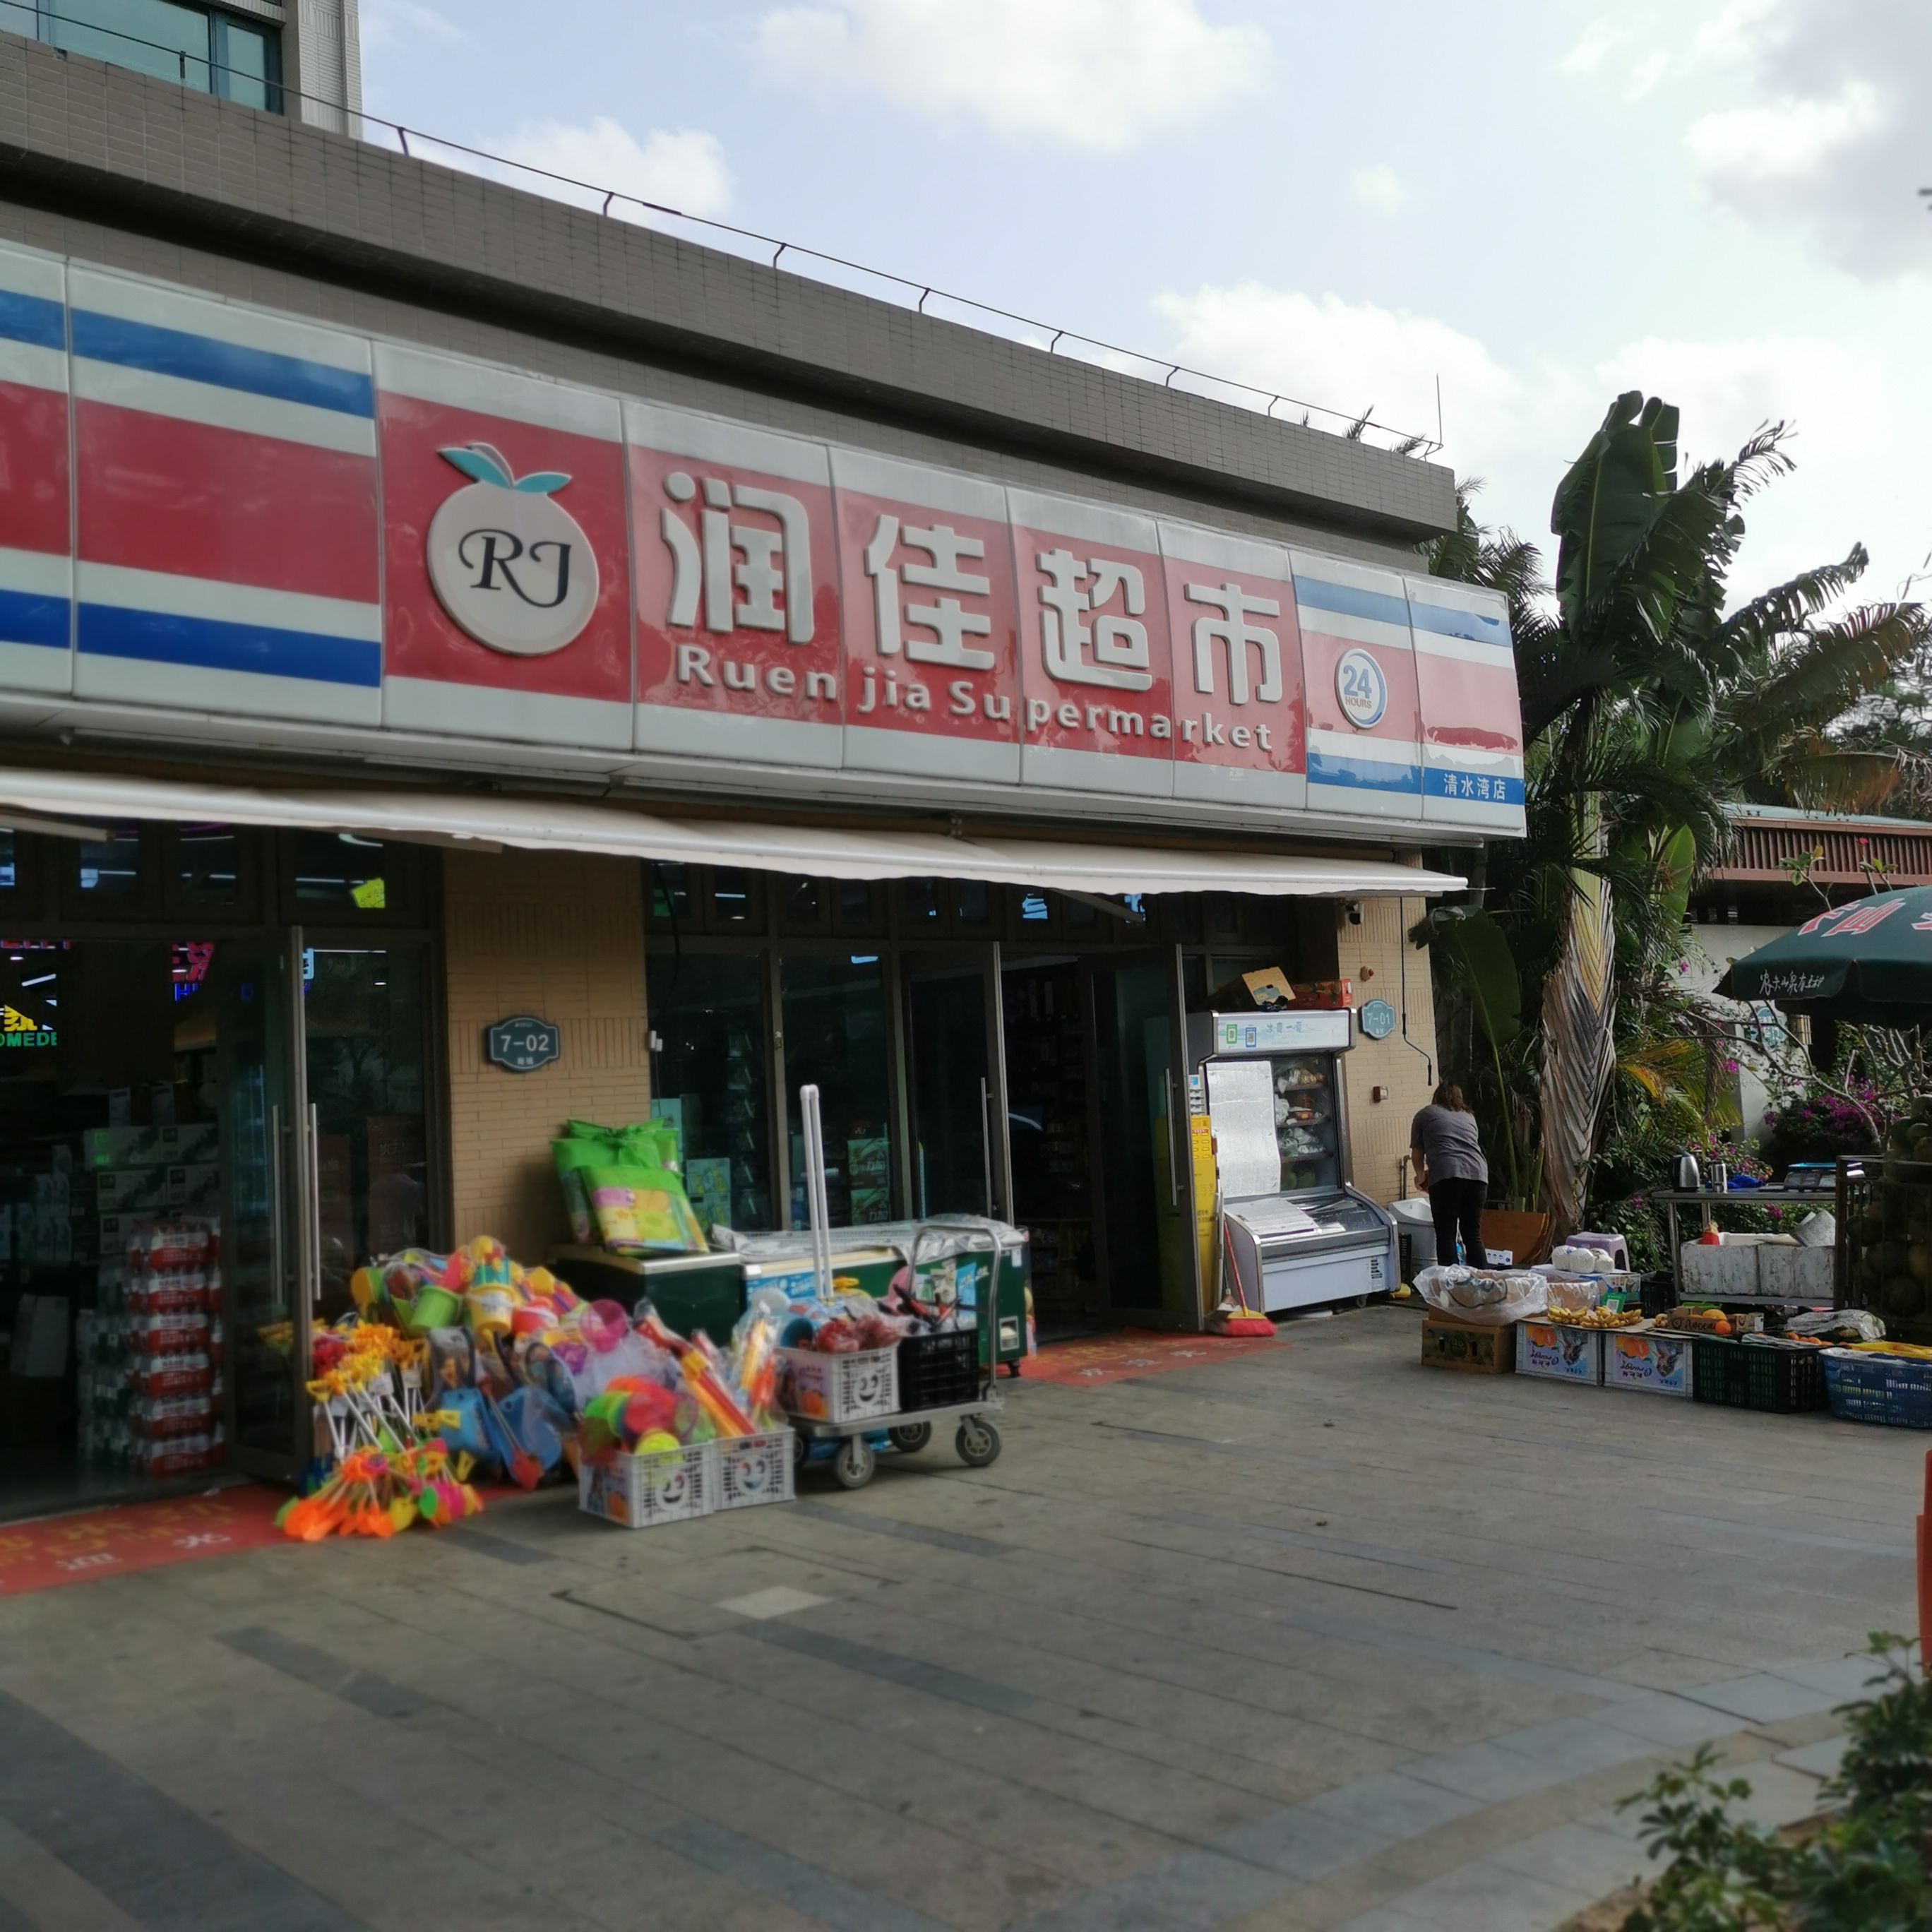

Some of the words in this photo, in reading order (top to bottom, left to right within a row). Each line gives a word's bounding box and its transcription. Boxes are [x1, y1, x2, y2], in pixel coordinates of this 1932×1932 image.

[458, 528, 572, 608] RJ
[660, 471, 1284, 705] 润佳超市
[1343, 665, 1372, 698] 24
[948, 681, 1272, 752] Supermarket
[1346, 696, 1372, 708] HOURS
[1443, 773, 1506, 801] 清水湾店
[1366, 1012, 1390, 1025] 7-01
[500, 1034, 550, 1053] 7-02
